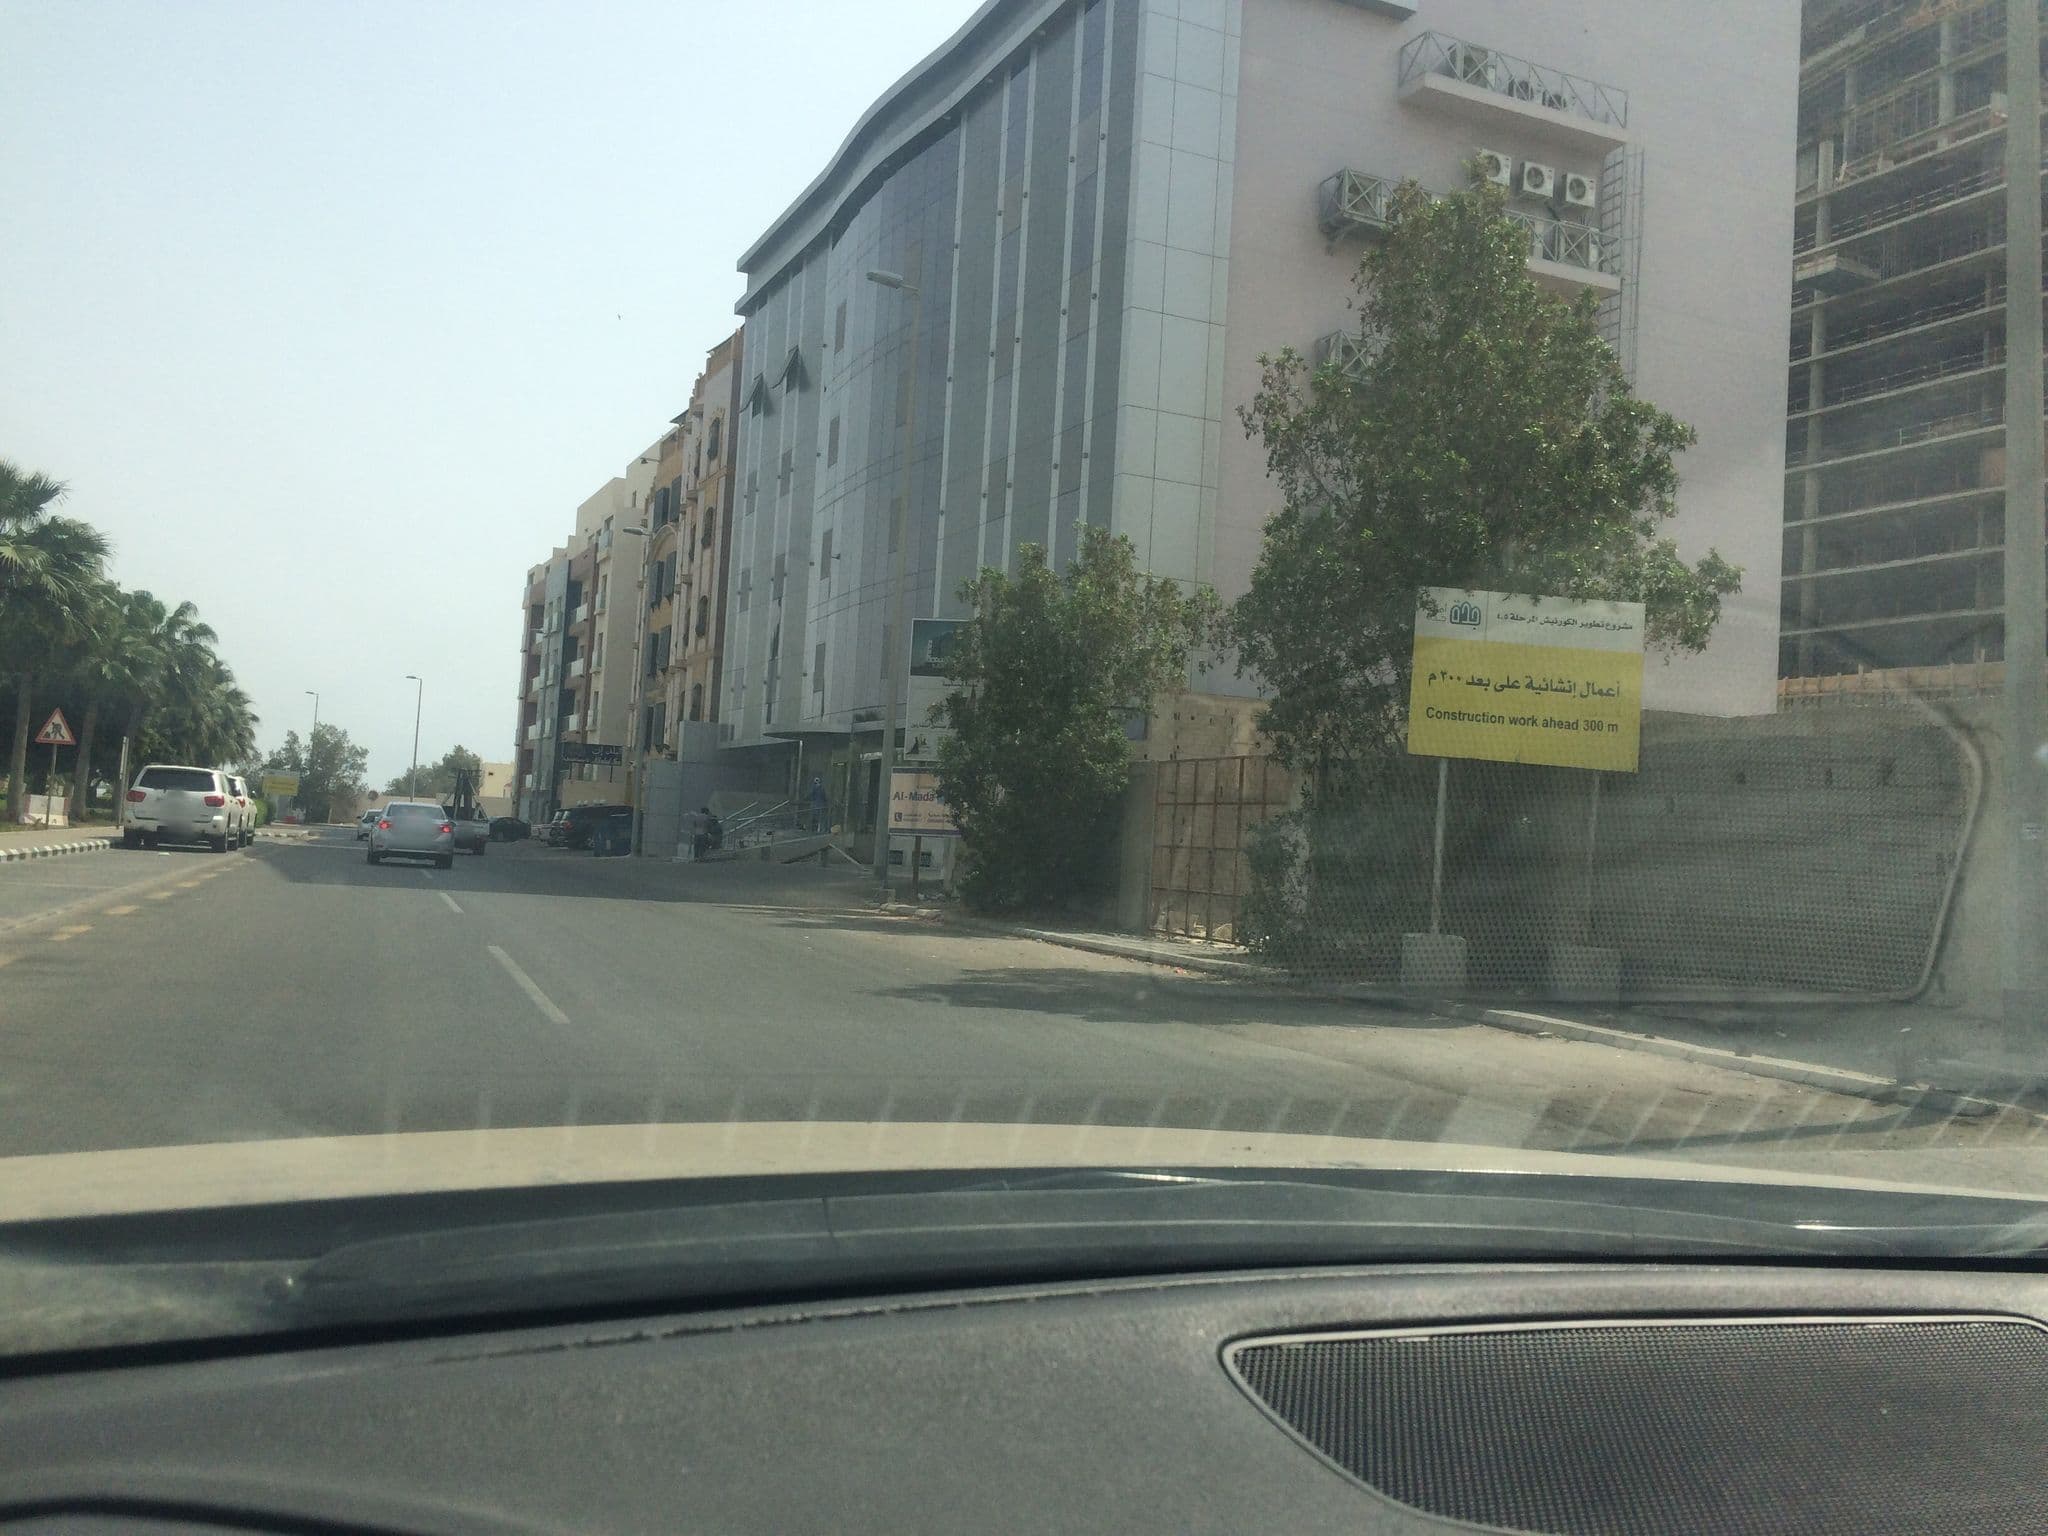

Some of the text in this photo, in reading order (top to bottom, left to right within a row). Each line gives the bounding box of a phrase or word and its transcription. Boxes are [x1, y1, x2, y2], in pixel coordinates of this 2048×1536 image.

[1605, 621, 1633, 632] مشروع
[1465, 674, 1491, 691] بعد
[1493, 675, 1521, 693] على
[1524, 674, 1577, 698] إنشائية
[1579, 680, 1621, 699] أعمال
[1425, 706, 1619, 733] Construction work ahead 300 m
